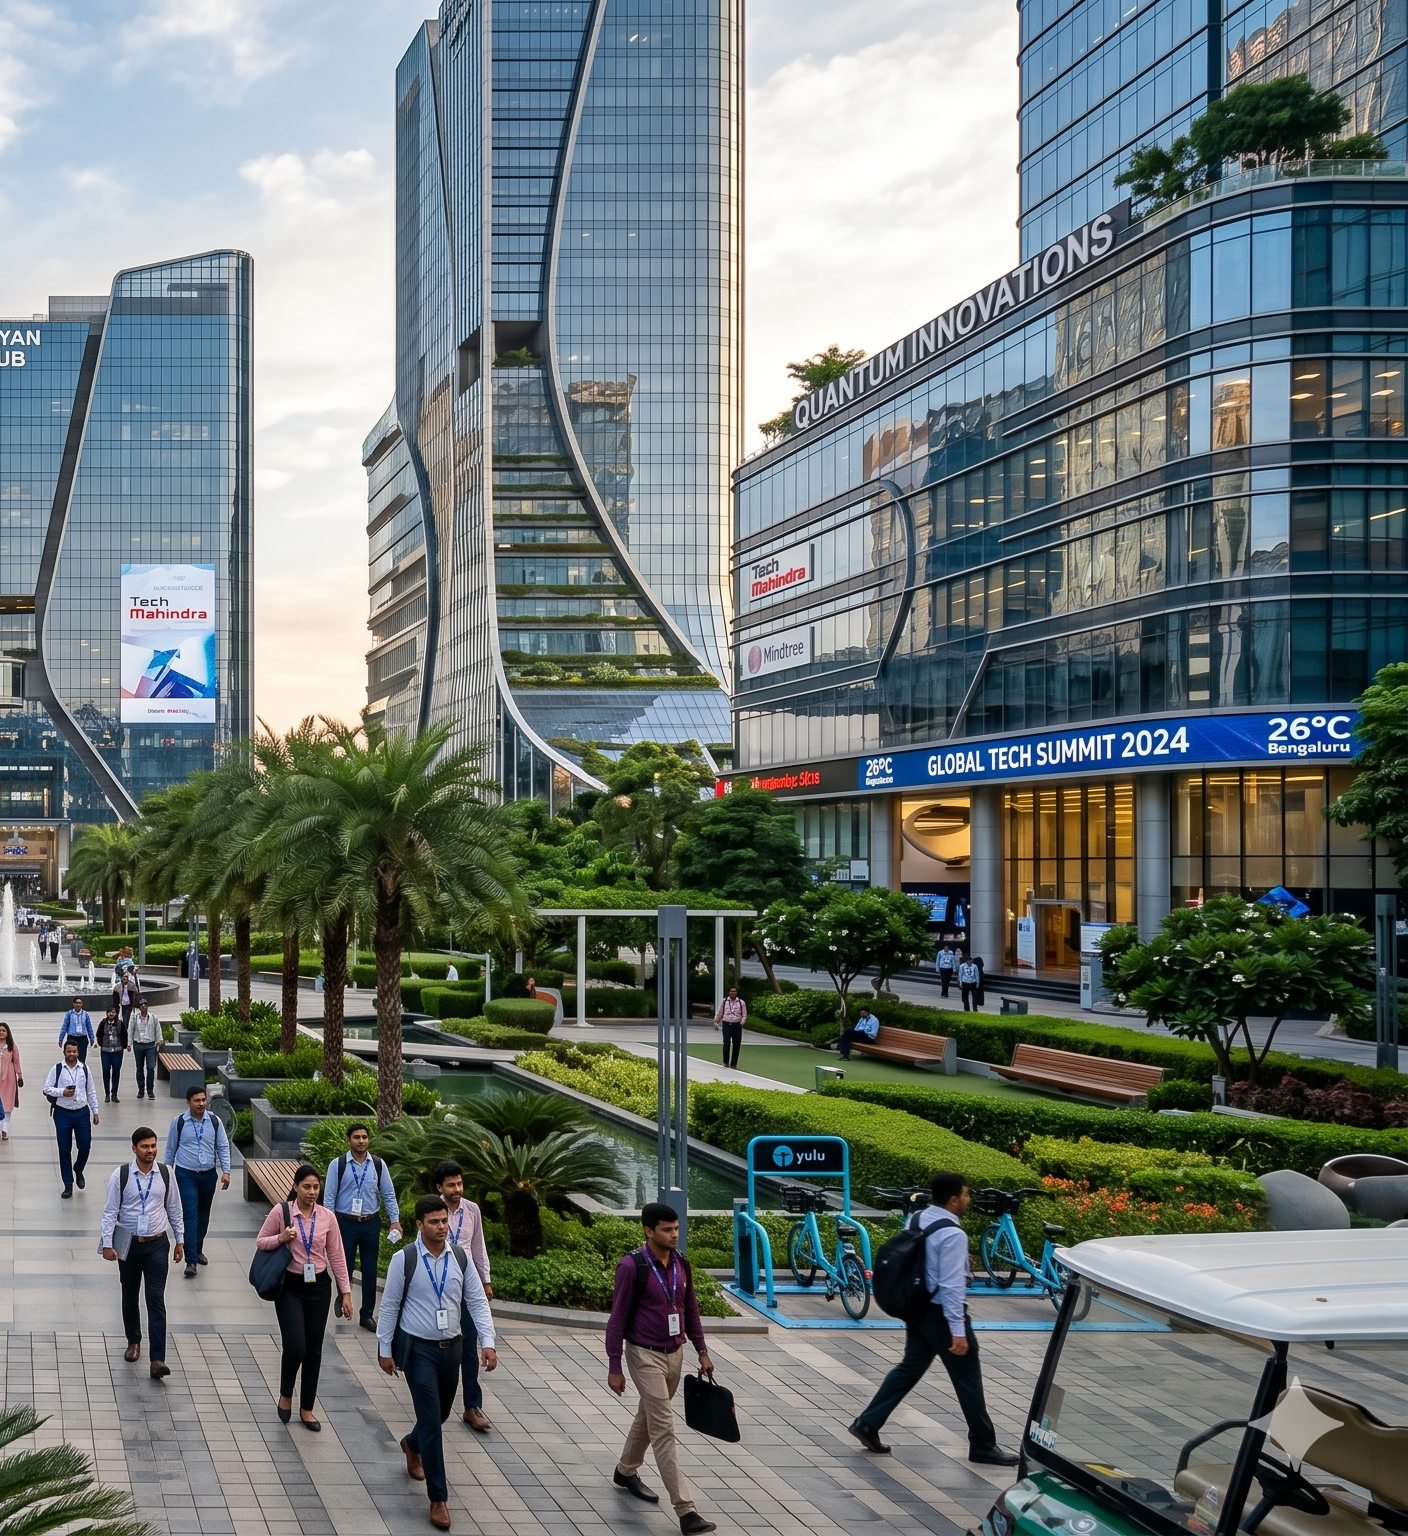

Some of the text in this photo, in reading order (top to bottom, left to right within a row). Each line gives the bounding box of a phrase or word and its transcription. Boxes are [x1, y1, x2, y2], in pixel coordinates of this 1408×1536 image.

[795, 213, 1115, 429] QUANTUM INNOVATIONS
[752, 557, 780, 580] Tech
[751, 566, 807, 598] Mahindra
[130, 597, 169, 607] Tech
[130, 608, 207, 619] Mahindra
[763, 641, 804, 664] Mindtree
[1266, 715, 1352, 740] 26°C
[927, 726, 1190, 777] GLOBAL TECH SUMMIT 2024
[1267, 741, 1351, 757] Bengaluru
[796, 1149, 825, 1164] yulu
